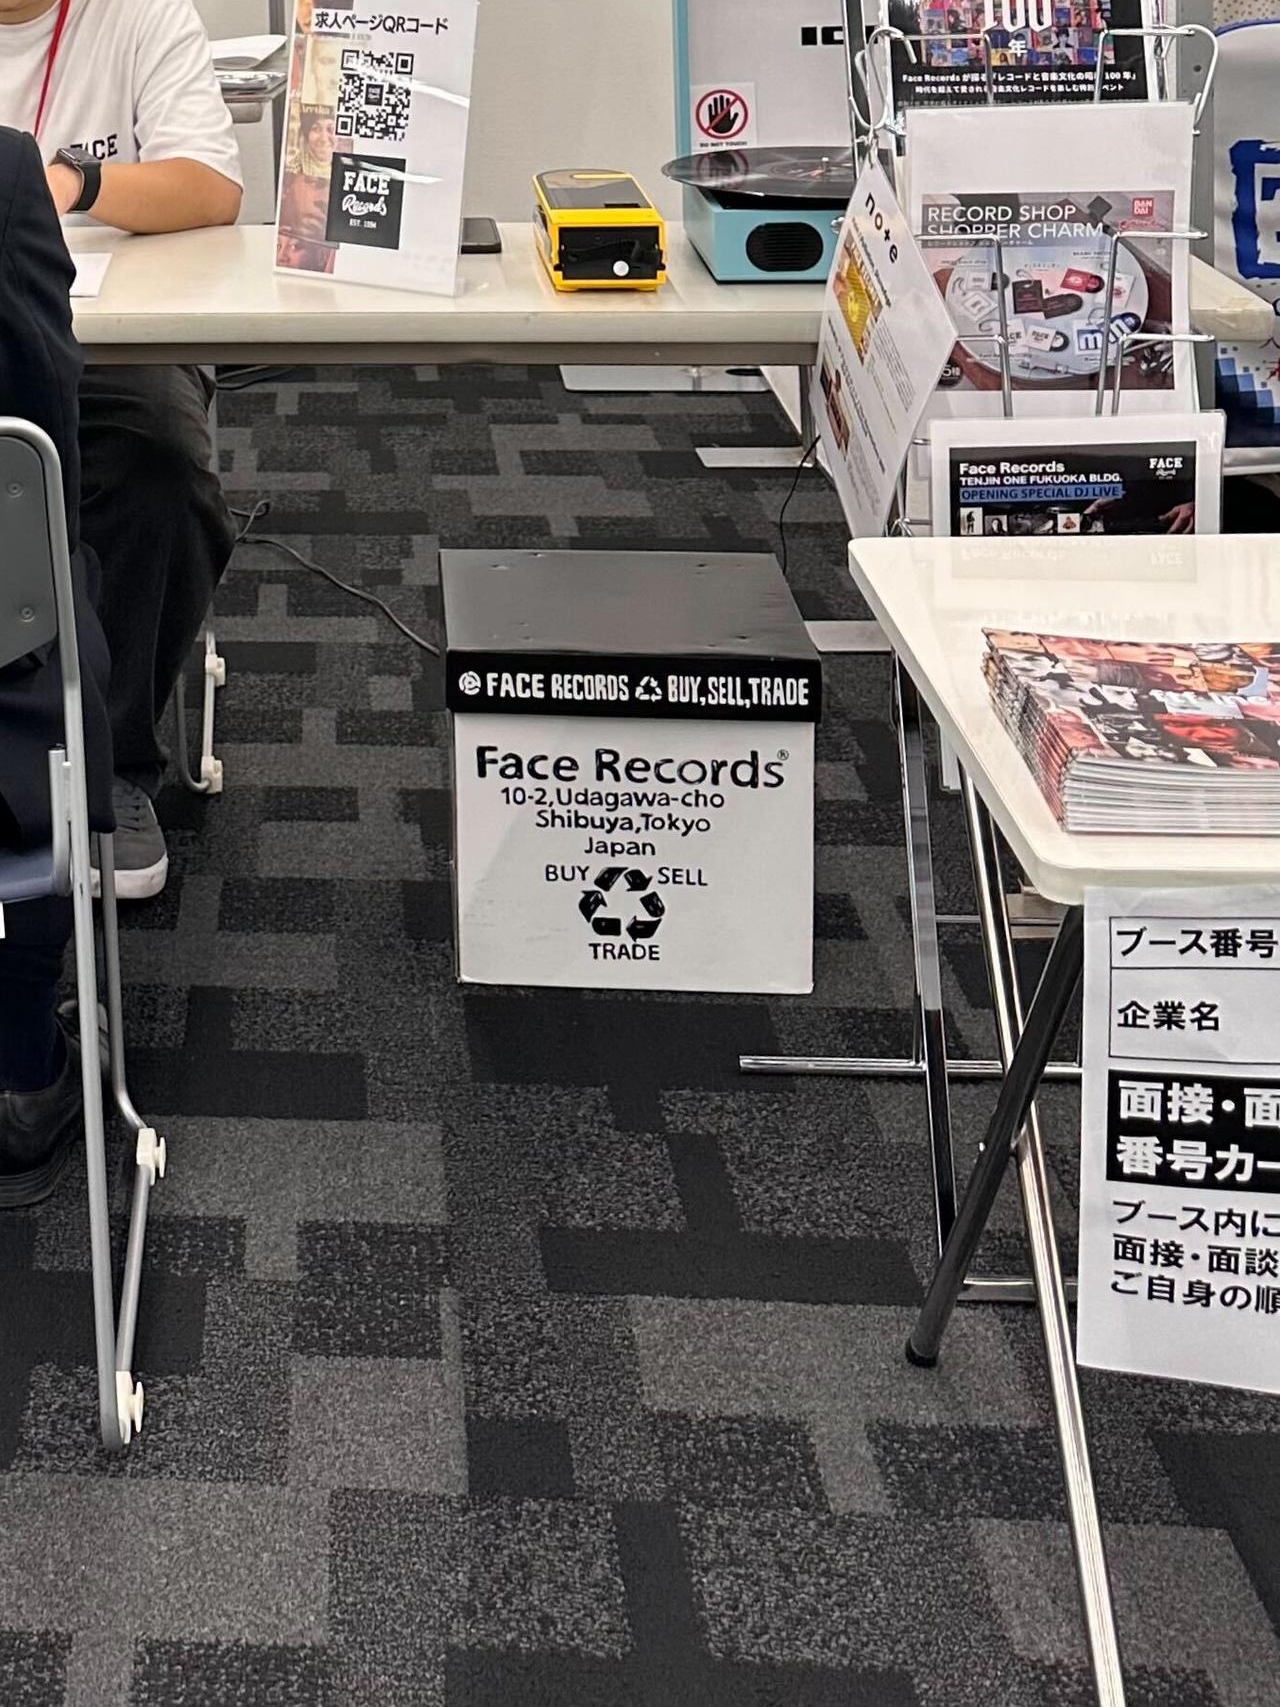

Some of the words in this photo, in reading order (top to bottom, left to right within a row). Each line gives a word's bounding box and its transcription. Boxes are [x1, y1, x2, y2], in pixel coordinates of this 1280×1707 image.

[314, 11, 449, 36] 求人ページQRコード
[1007, 39, 1028, 58] 年
[902, 74, 923, 82] Face
[342, 170, 391, 196] FACE
[341, 193, 388, 216] Records
[927, 205, 1012, 222] RECORD
[1020, 204, 1076, 221] SHOP
[1028, 222, 1104, 239] CHARM
[960, 462, 996, 475] Face
[1000, 460, 1065, 474] Records
[1149, 457, 1183, 470] FACE
[960, 476, 1001, 486] TENJIN
[1003, 475, 1027, 485] ONE
[1030, 474, 1086, 484] FUKUOKA
[1089, 472, 1123, 482] BLDG.
[961, 488, 1019, 500] OPENING
[1021, 487, 1071, 499] SPECIAL
[1074, 486, 1091, 498] DJ
[1092, 485, 1119, 497] LIVE
[486, 672, 545, 699] FACE
[551, 674, 629, 701] RECORDS
[476, 746, 579, 781] Face
[501, 786, 726, 812] 10-2,Udagawa-cho
[535, 809, 711, 837] Shibuya,Tokyo
[584, 836, 656, 858] Japan
[545, 864, 590, 882] BUY
[657, 866, 708, 887] SELL
[588, 942, 661, 961] TRADE
[1116, 926, 1279, 960] ブース番号
[1117, 999, 1221, 1032] 企業名
[1113, 1199, 1280, 1239] ブース内に
[1113, 1232, 1279, 1279] 面接・面談
